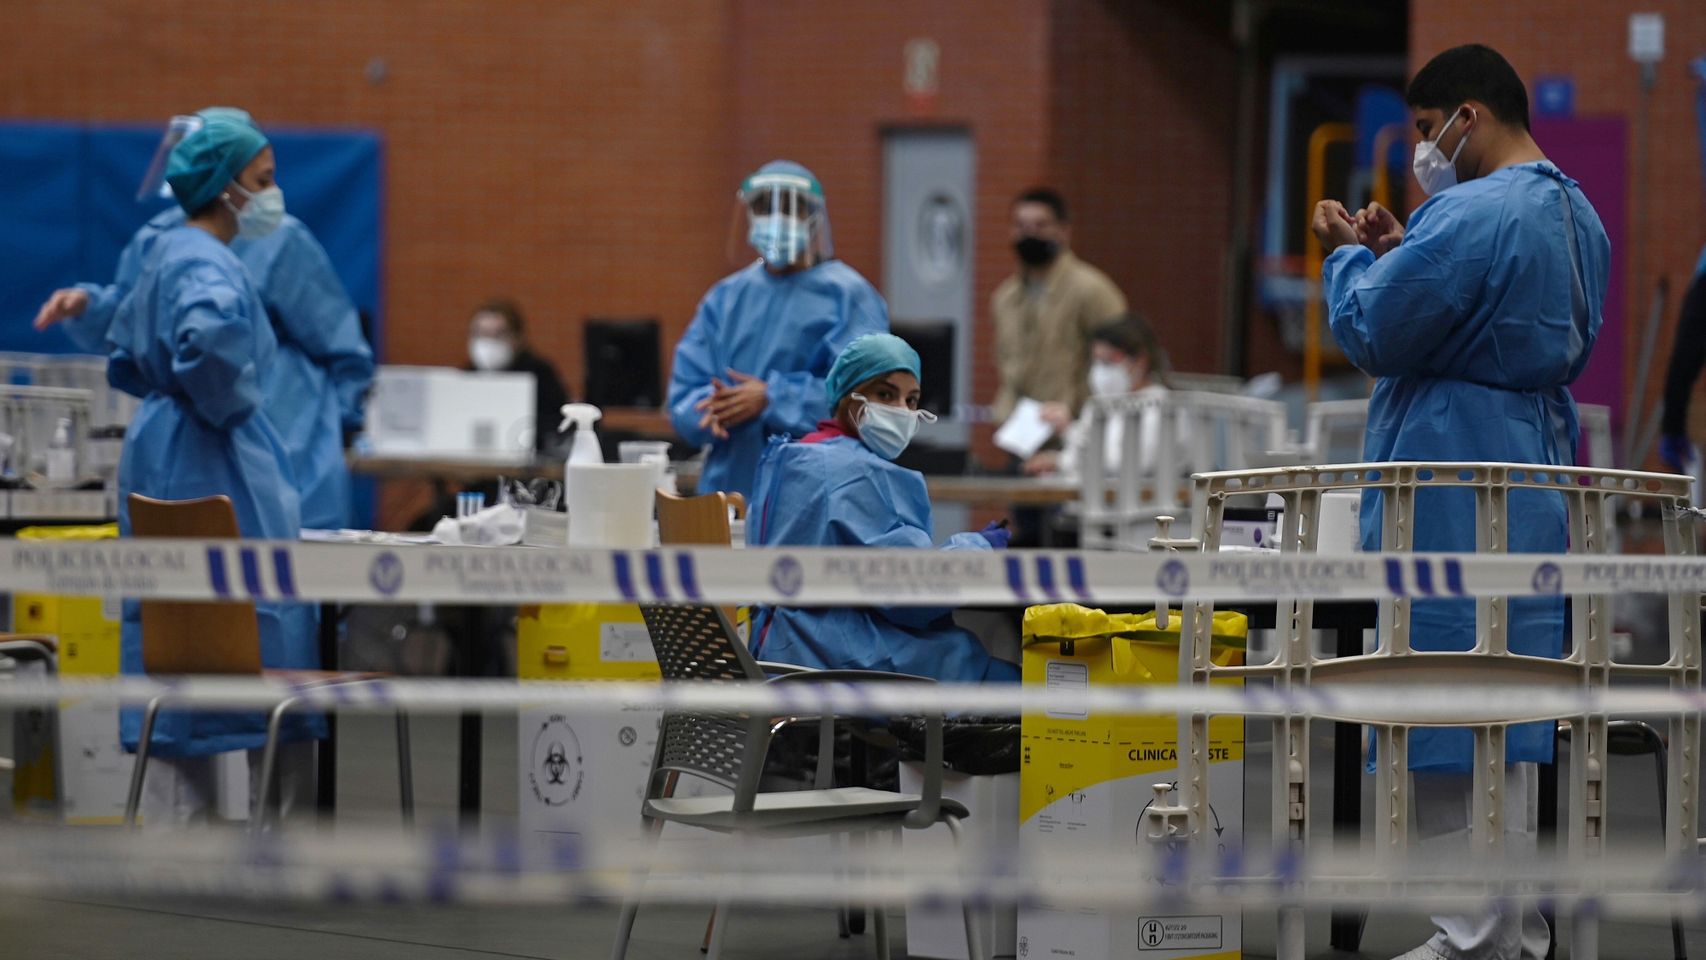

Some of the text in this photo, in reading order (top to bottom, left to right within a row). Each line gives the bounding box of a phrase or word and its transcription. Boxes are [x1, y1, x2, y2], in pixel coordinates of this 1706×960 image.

[110, 547, 186, 571] LOCAL
[1668, 561, 1706, 581] LOC
[1128, 748, 1178, 761] CLINICA
